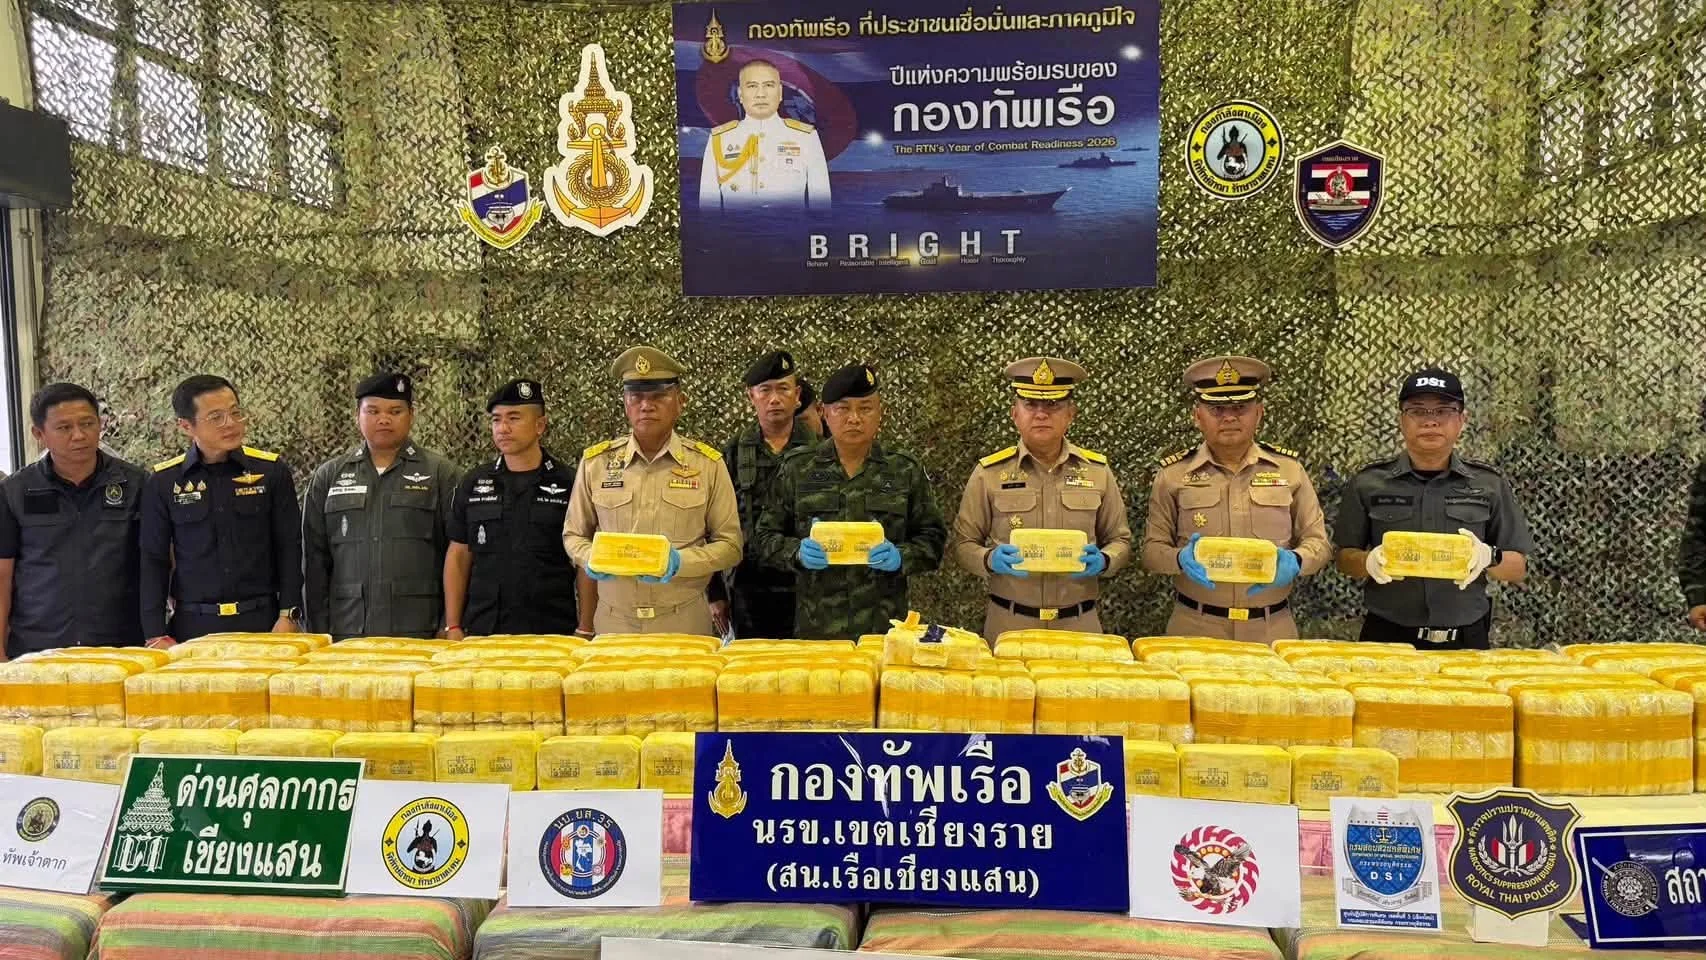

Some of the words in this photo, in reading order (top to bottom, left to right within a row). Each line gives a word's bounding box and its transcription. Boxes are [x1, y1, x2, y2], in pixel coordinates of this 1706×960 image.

[748, 16, 850, 39] กองทัพเรือ
[859, 6, 1136, 35] ที่ประชาชนเชื่อมั่นและภาคภูมิใจ
[890, 60, 1118, 86] ปีแห่งความพร้อมรบของ
[893, 83, 1116, 132] กองทัพเรือ
[895, 145, 912, 154] The
[916, 143, 944, 153] RTN's
[949, 143, 971, 152] Year
[975, 142, 985, 151] of
[988, 141, 1028, 151] Combat
[1031, 139, 1084, 150] Readiness
[1087, 137, 1116, 147] 2026
[1415, 377, 1447, 388] DSI
[770, 739, 1031, 804] กองทัพเรือ
[176, 763, 358, 828] ด่านศุลกากร
[752, 806, 1053, 850] นรข.เขตเชียงราย
[182, 824, 322, 878] เชียงแสน
[1468, 846, 1493, 882] NARCOTICS
[1493, 876, 1541, 890] SUPPRESSION
[1540, 852, 1557, 879] BUREAU
[766, 852, 1040, 898] (สน.เรือเชียงแสน)
[1465, 873, 1495, 899] ROYAL
[1499, 891, 1522, 903] THAI
[1524, 879, 1560, 903] POLICE
